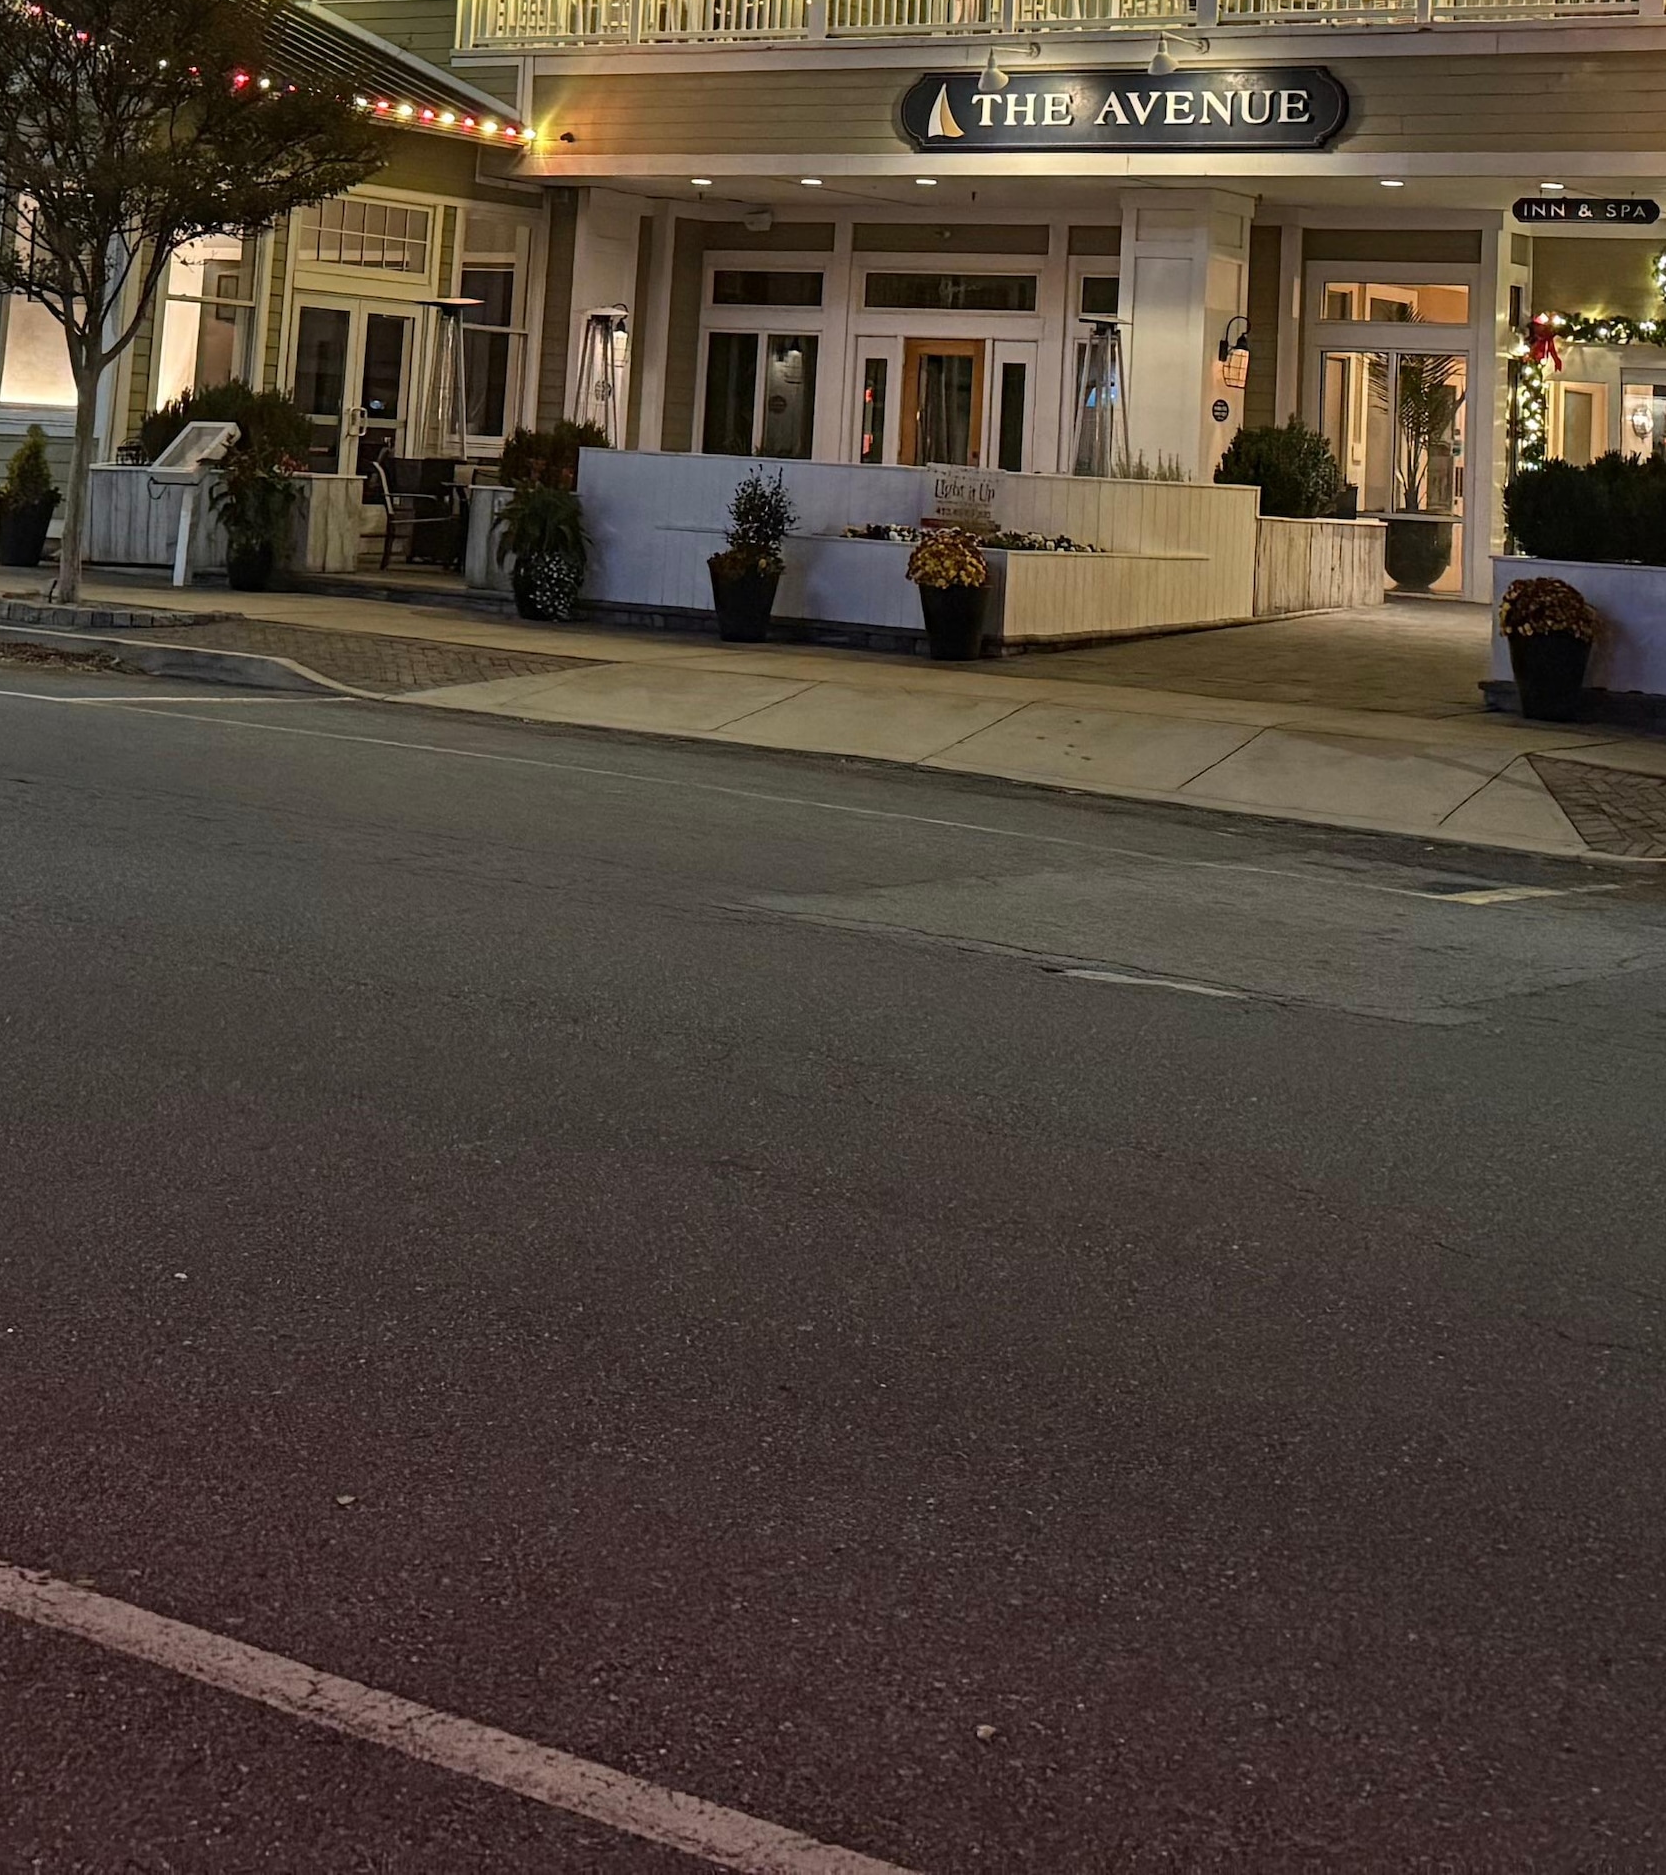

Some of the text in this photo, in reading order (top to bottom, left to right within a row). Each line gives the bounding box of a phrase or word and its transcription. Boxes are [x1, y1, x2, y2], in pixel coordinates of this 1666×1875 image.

[971, 89, 1310, 126] THE AVENUE
[1523, 203, 1646, 218] INN & SPA
